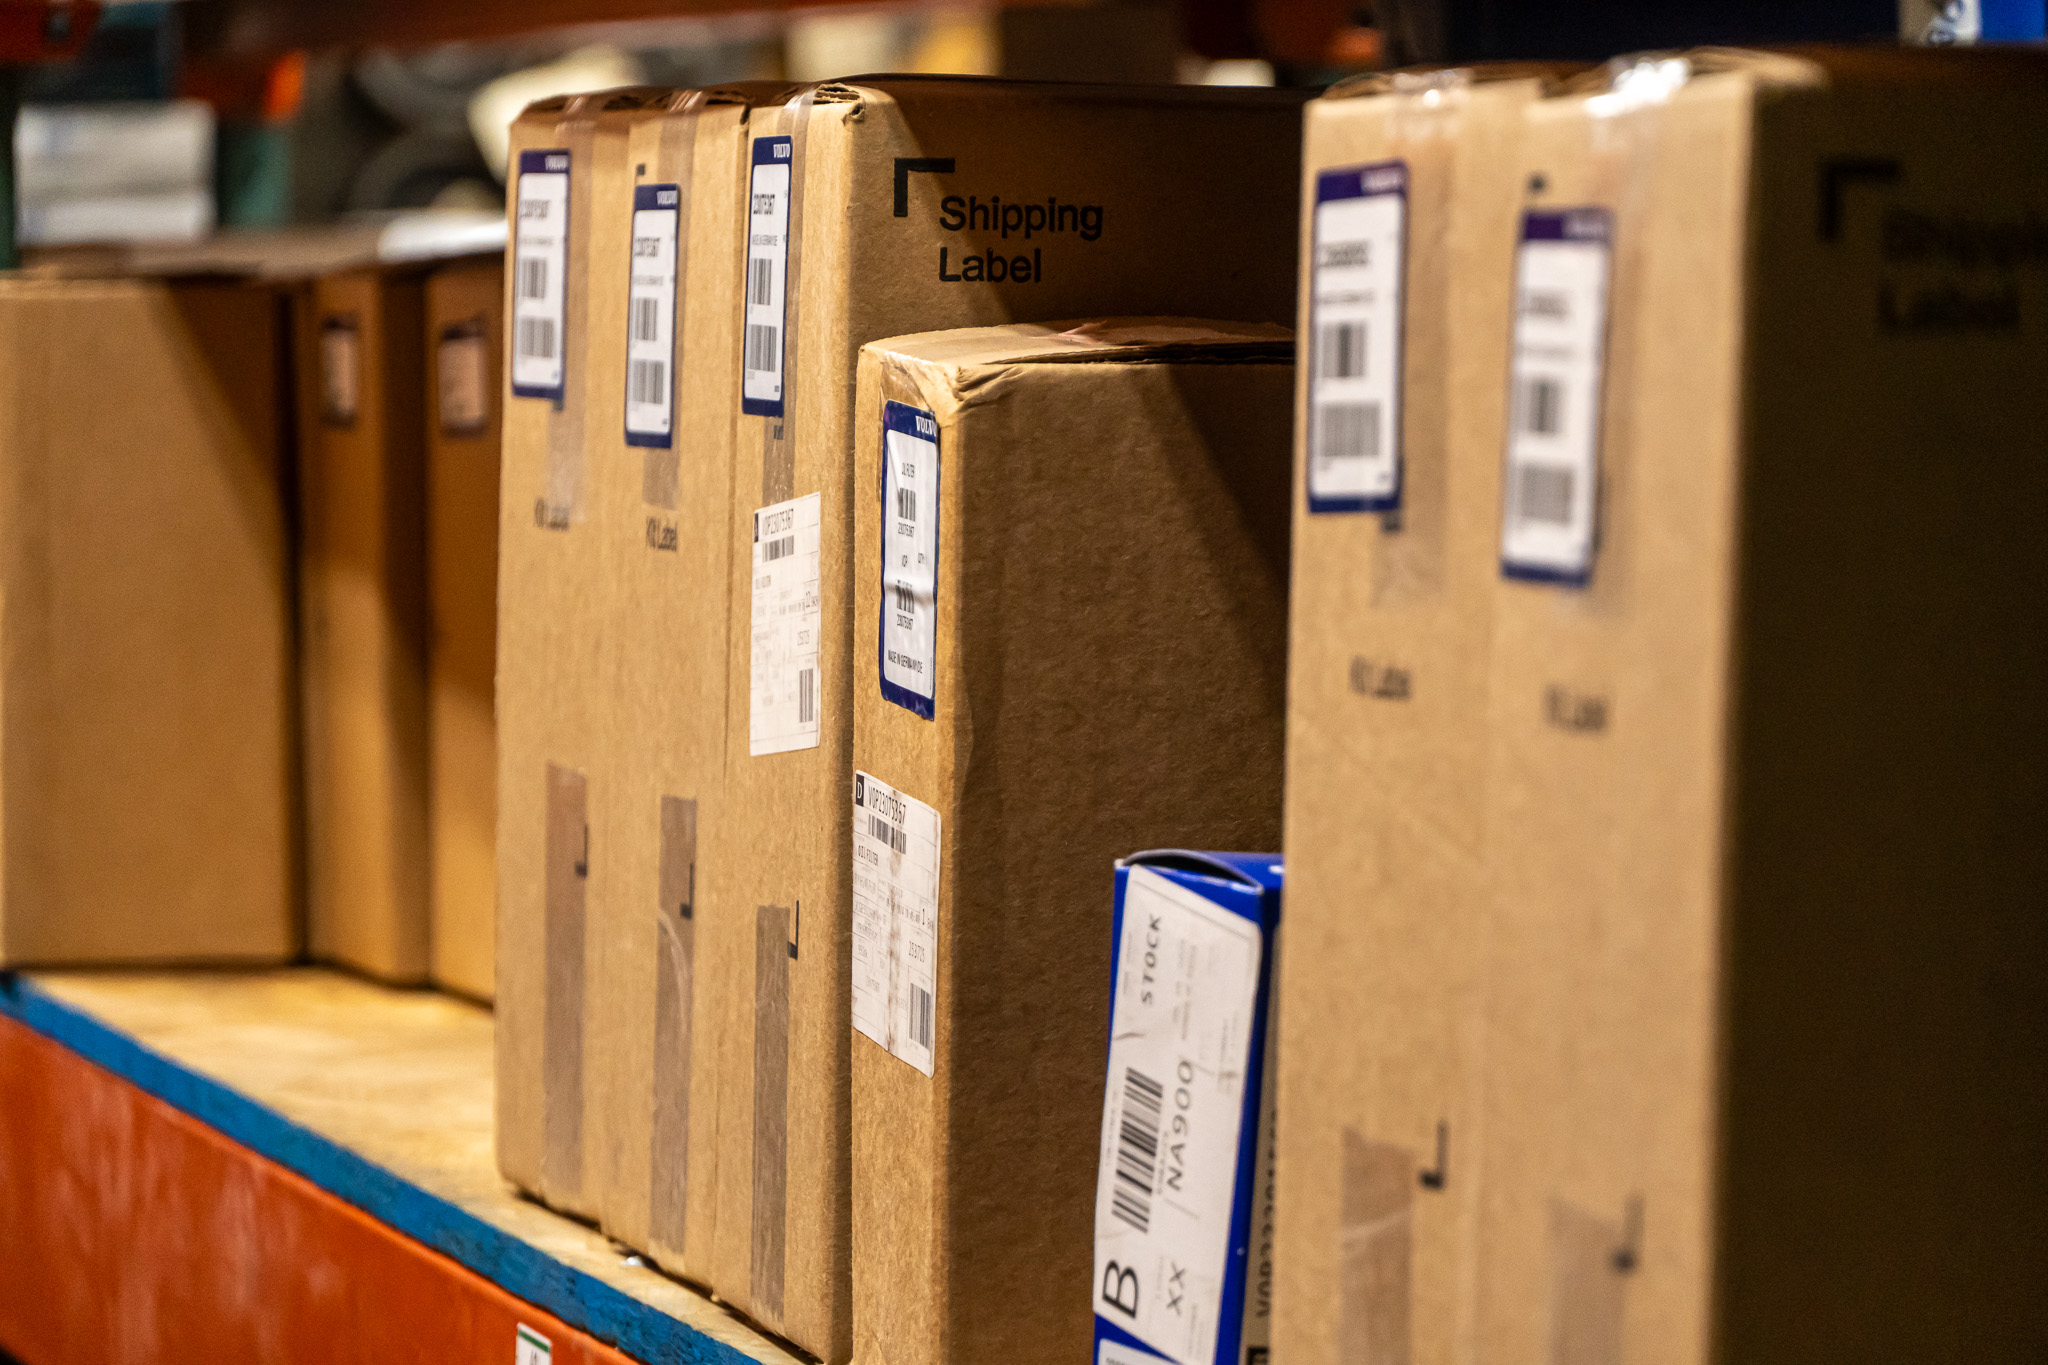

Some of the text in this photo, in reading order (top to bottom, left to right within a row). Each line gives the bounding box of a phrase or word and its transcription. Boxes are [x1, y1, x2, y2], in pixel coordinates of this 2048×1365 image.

[939, 195, 1103, 241] Shipping
[939, 247, 1041, 283] Label
[915, 415, 936, 437] VOLVO
[1140, 913, 1162, 1005] STOCK
[1166, 1059, 1193, 1192] NA900
[1101, 1259, 1140, 1320] B
[1166, 1261, 1186, 1318] XX
